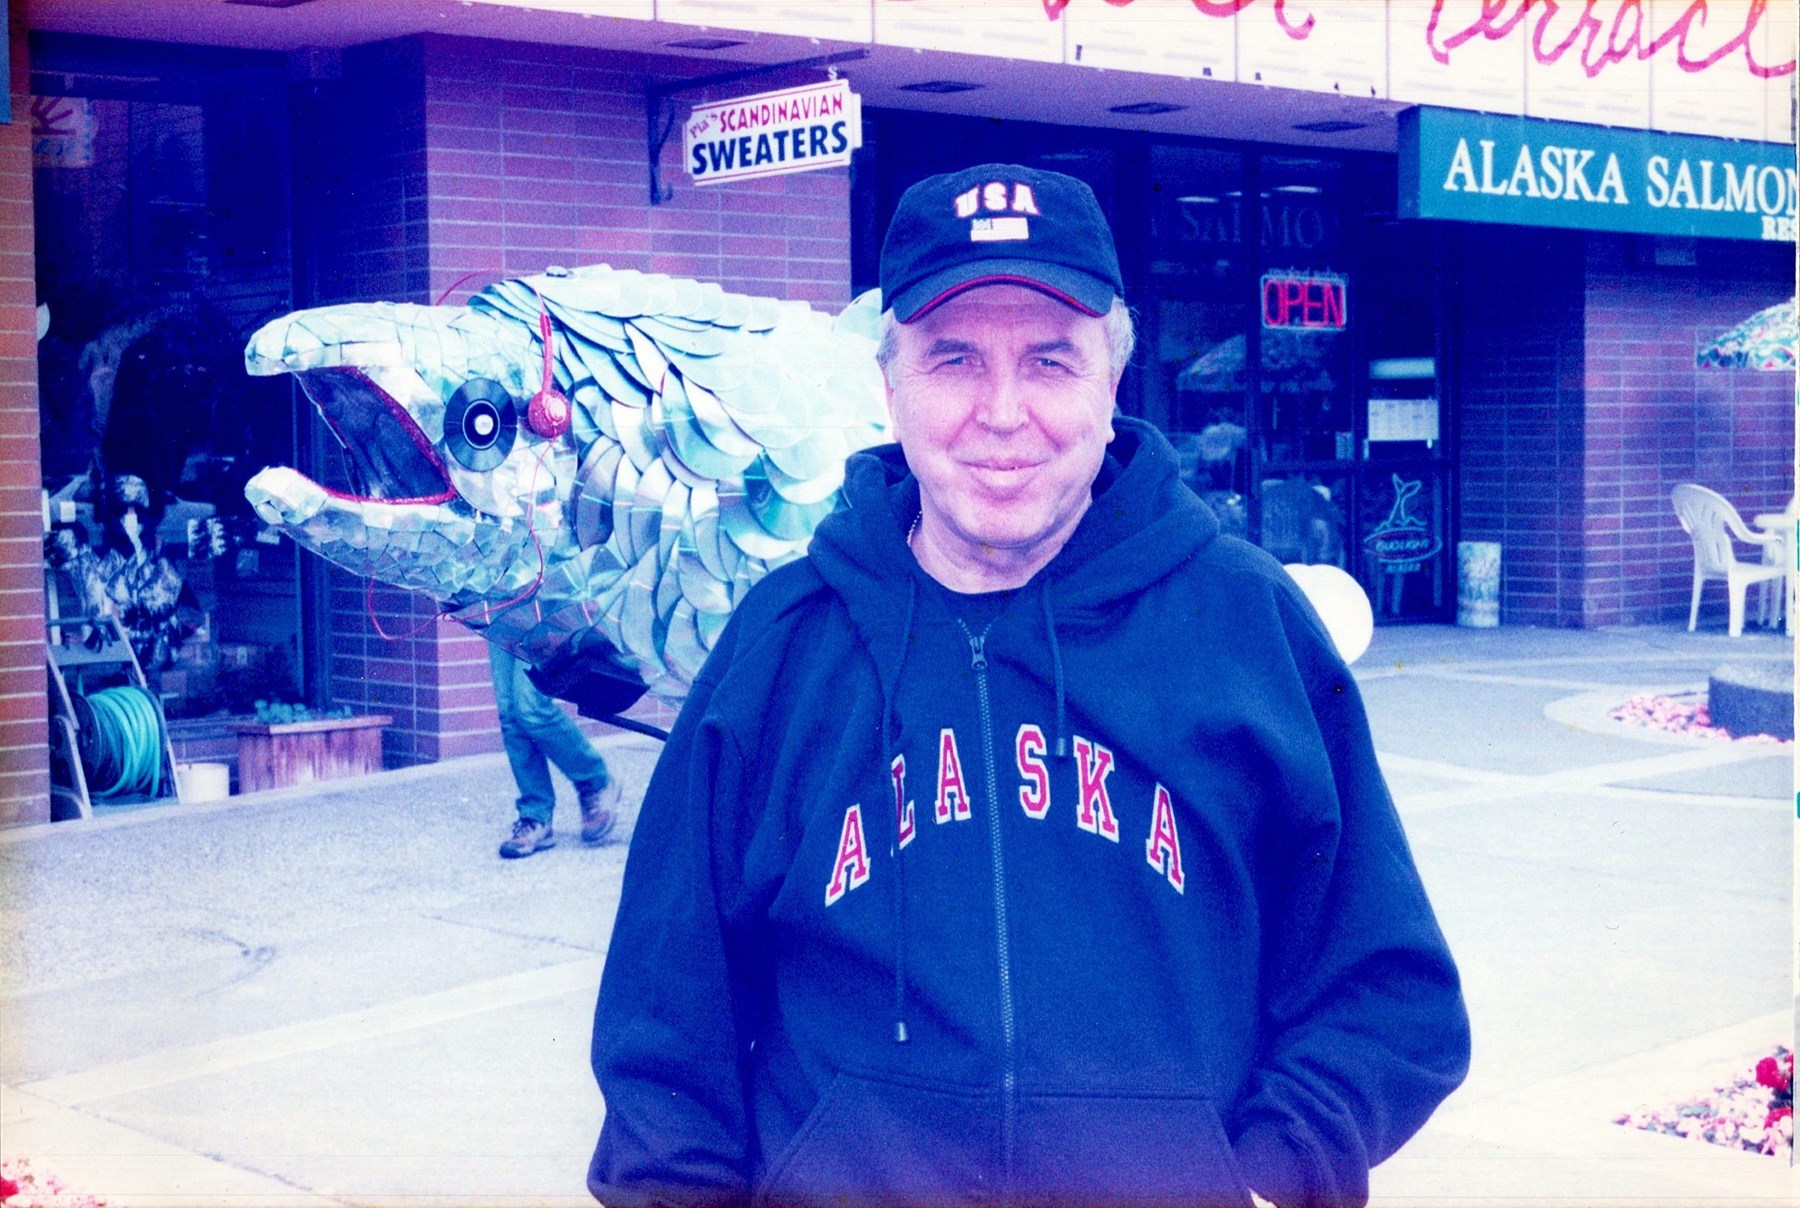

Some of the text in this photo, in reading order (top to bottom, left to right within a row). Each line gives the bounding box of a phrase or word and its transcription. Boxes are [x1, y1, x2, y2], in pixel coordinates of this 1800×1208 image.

[720, 92, 843, 133] SCANDINAVIAN
[692, 120, 848, 175] SWEATERS
[1443, 138, 1628, 204] ALASKA
[953, 181, 1042, 218] USA
[1264, 278, 1344, 328] OPEN
[825, 724, 1184, 907] ALASKA
